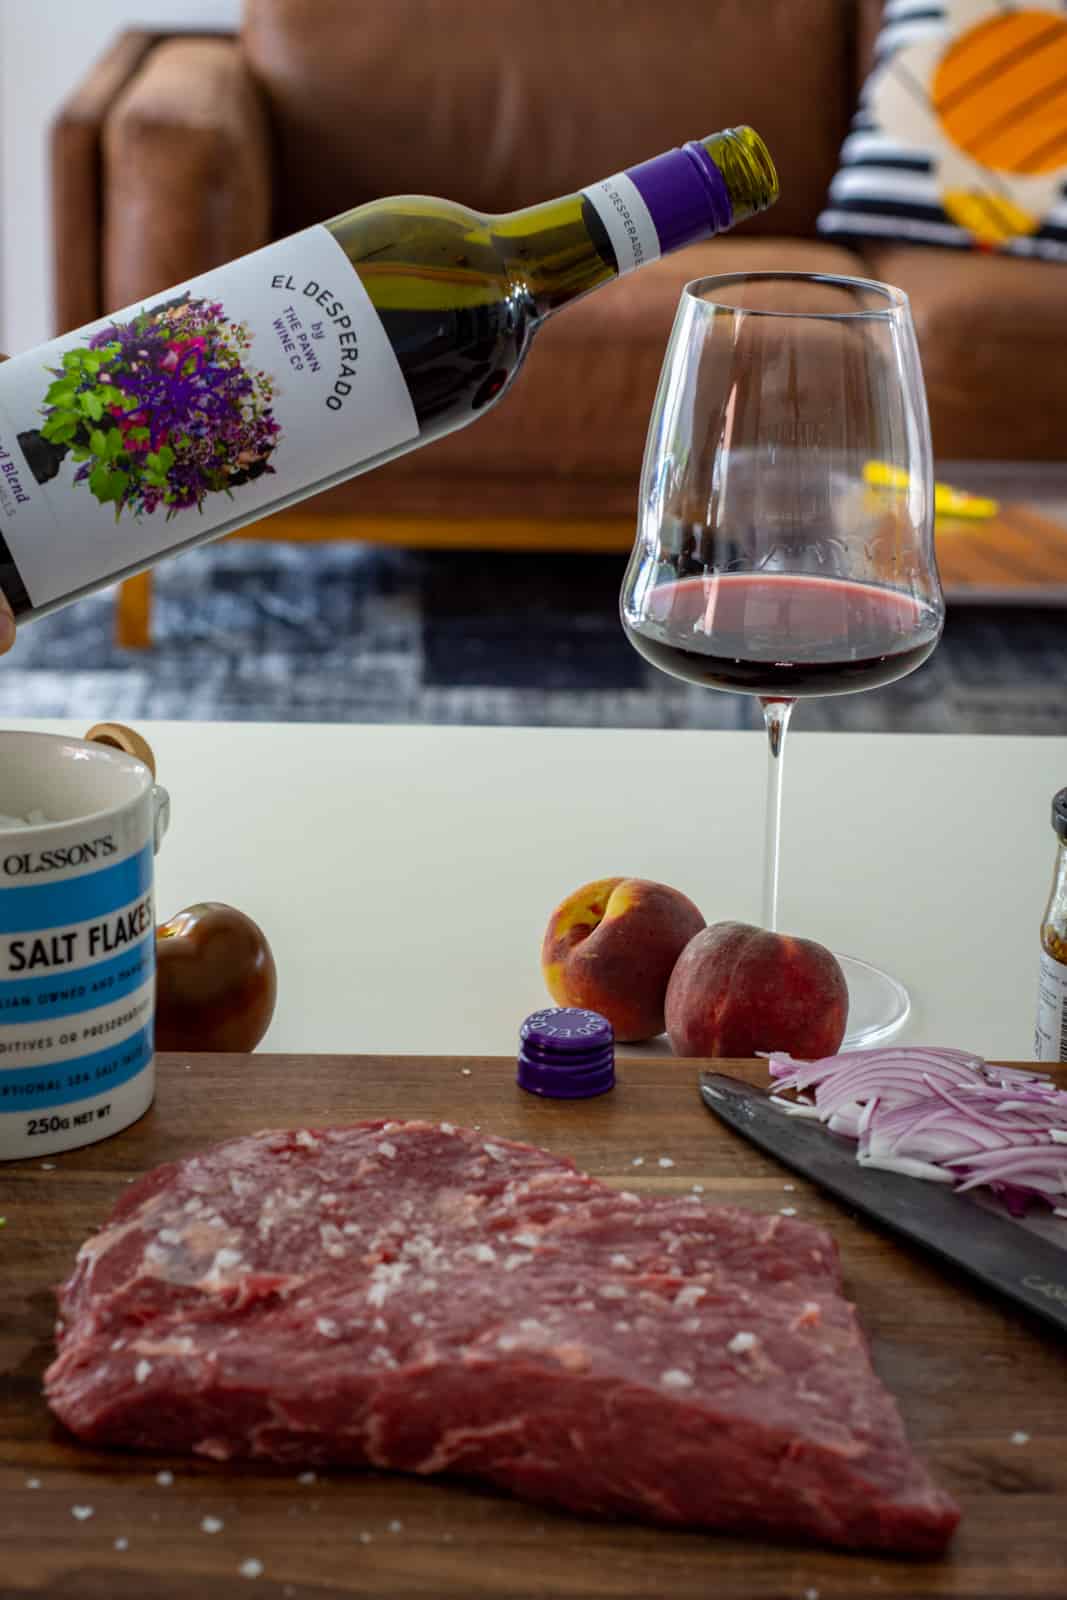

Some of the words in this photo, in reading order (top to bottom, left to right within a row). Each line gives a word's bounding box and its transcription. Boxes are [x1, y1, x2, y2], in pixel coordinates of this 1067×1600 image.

[609, 192, 643, 257] DESPERADO
[271, 275, 297, 291] EL
[302, 280, 359, 411] DESPERADO
[272, 318, 296, 353] WINE
[282, 305, 303, 332] THE
[298, 333, 321, 373] PAWN
[311, 321, 327, 340] by
[1, 462, 31, 504] Blend
[8, 932, 78, 972] SALT
[88, 895, 153, 957] FLAKES
[38, 986, 86, 1005] OWNED
[92, 976, 115, 992] AND
[59, 1032, 78, 1046] OR
[67, 1072, 90, 1087] SEA
[95, 1061, 118, 1078] SALT
[73, 1111, 93, 1127] NET
[96, 1104, 112, 1119] WT
